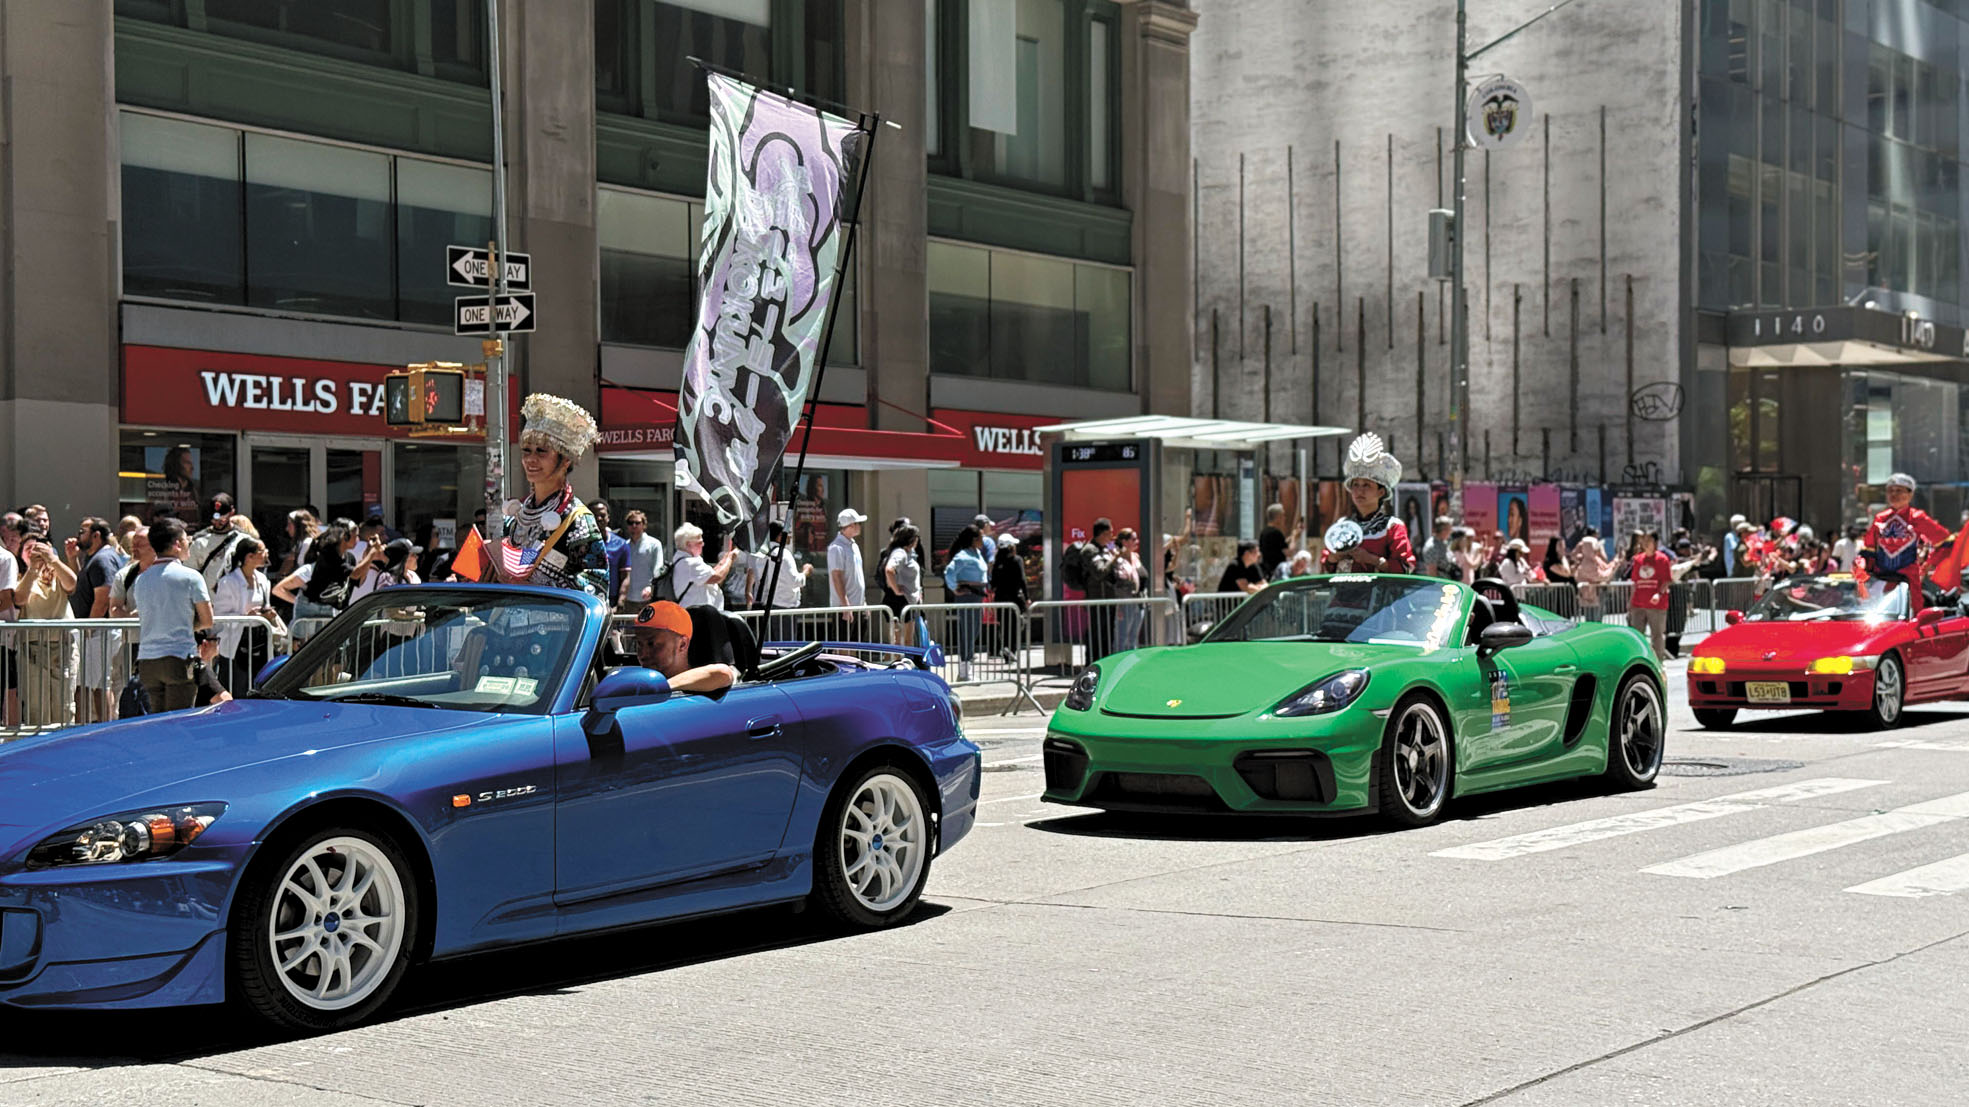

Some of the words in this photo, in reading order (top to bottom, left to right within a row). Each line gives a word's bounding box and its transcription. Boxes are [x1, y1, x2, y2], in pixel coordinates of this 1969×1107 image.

[464, 261, 486, 275] ONE
[506, 265, 521, 279] AY
[464, 308, 485, 322] ONE
[496, 306, 519, 320] WAY
[1755, 315, 1825, 336] 1140
[201, 371, 338, 413] WELLS
[597, 429, 644, 444] WELLS
[975, 426, 1043, 455] WELLS
